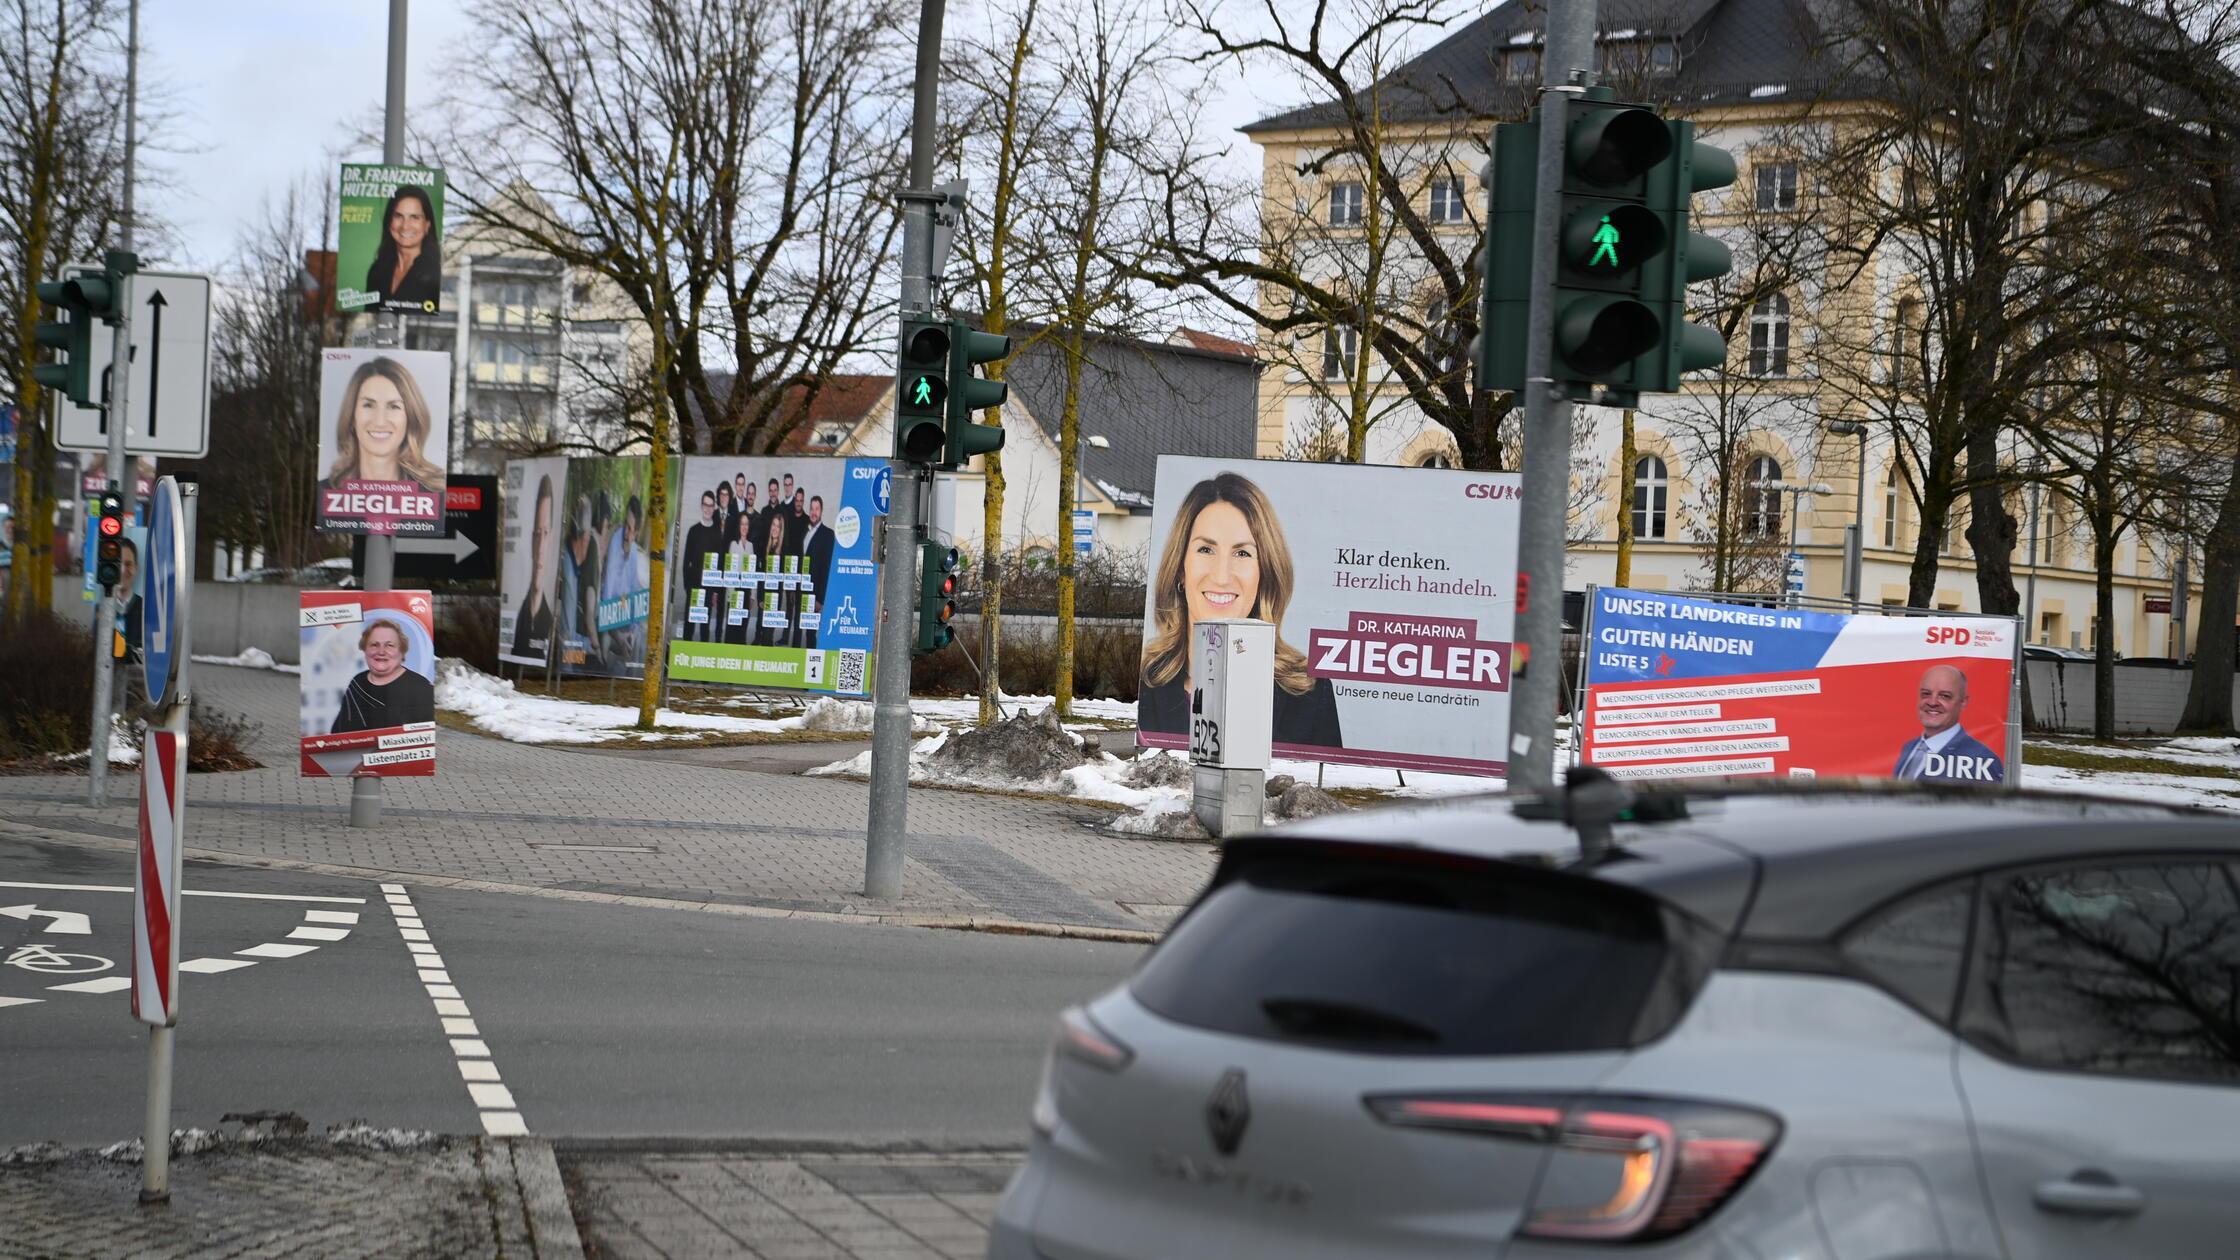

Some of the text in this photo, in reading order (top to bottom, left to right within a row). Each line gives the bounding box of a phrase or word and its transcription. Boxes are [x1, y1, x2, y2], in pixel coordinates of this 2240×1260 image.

[343, 167, 434, 186] DR. FRANZISKA
[347, 483, 413, 493] DR. KATHARINA
[1465, 483, 1504, 499] CSU
[326, 493, 435, 516] ZIEGLER
[325, 519, 435, 532] Unsere neue Landrätin
[1337, 548, 1450, 571] Klar denken.
[1335, 571, 1497, 597] Herzlich handeln.
[600, 598, 631, 625] MARTIN
[1603, 597, 1801, 630] UNSER LANDKREIS IN
[1357, 619, 1466, 639] DR. KATHARINA
[1926, 626, 1970, 645] SPD
[1601, 627, 1754, 656] GUTEN HÄNDEN
[674, 652, 689, 666] FÜR
[690, 655, 716, 668] JUNGE
[717, 657, 741, 670] IDEEN
[753, 660, 799, 674] NEUMARKT
[1315, 637, 1502, 684] ZIEGLER
[1599, 652, 1649, 670] LISTE 5
[811, 666, 817, 678] 1
[1335, 685, 1480, 707] Unsere neue Landrätin
[1602, 683, 1815, 703] MEDIZINISCHE VERSORGUNG UND PFLEGE WEITERDENKEN
[1601, 708, 1714, 722] MEHR REGION AUF DEM TELLER
[1599, 722, 1768, 740] DEMOGRAFISCHEN WANDEL AKTIV GESTALTEN
[368, 749, 430, 764] Listenplatz 12
[1597, 741, 1779, 759] ZUKUNFTSFÄHIGE MOBILITÄT FÜR DEN LANDKREIS
[1656, 765, 1706, 775] HOCHSCHULE
[1708, 763, 1723, 772] FÜR
[1724, 761, 1766, 771] NEUMARKT
[1925, 753, 1995, 781] DIRK
